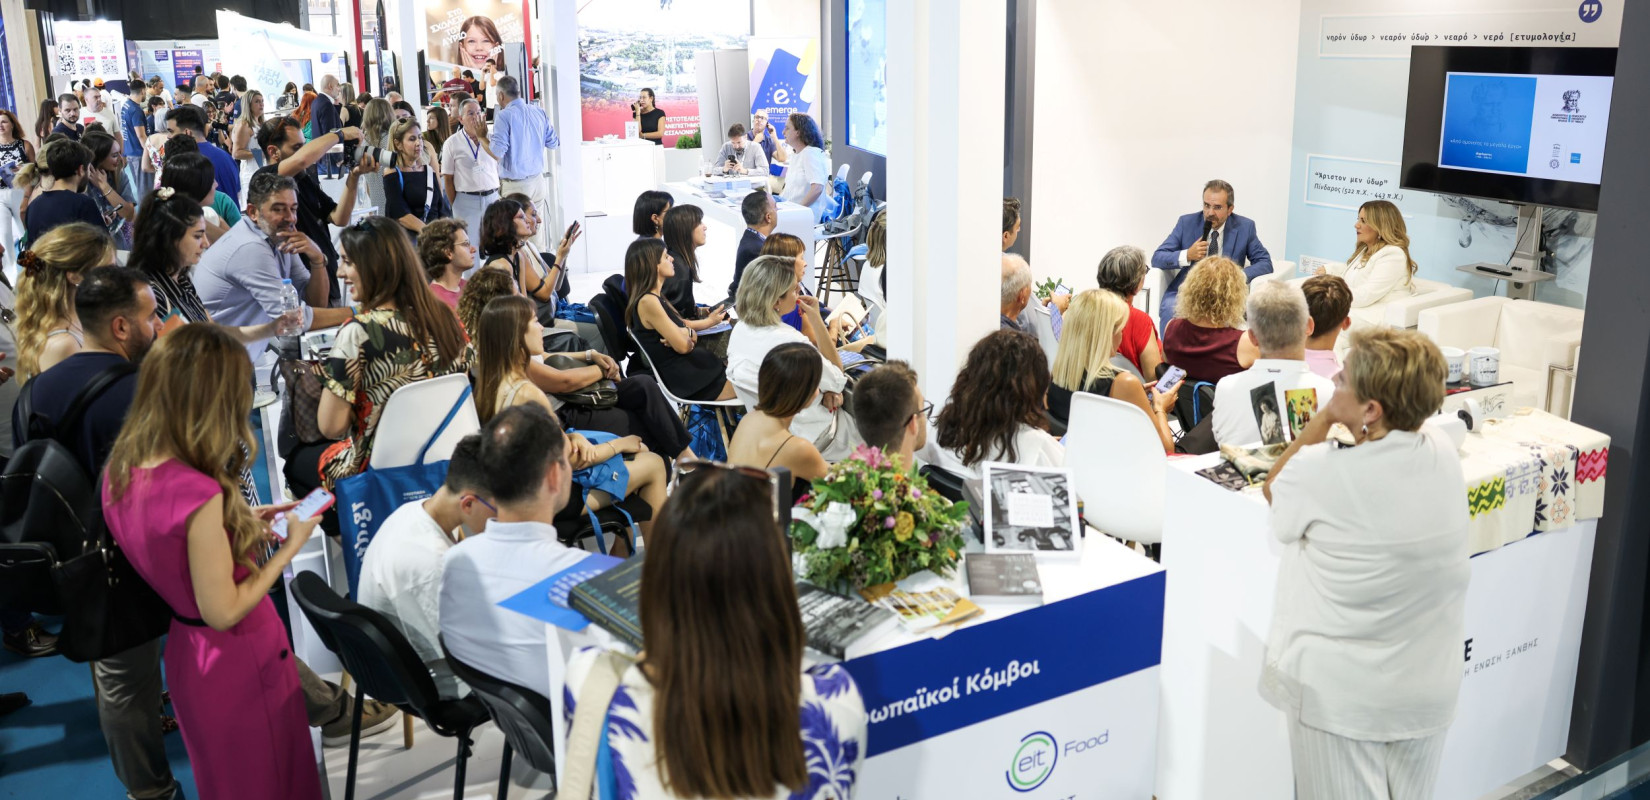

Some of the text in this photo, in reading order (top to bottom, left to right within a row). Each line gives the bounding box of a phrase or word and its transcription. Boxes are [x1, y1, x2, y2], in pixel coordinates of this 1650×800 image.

[1380, 33, 1407, 42] νεαρόν
[1444, 32, 1468, 42] νεαρό
[1483, 32, 1504, 42] νερό
[765, 107, 798, 117] emerge
[1350, 176, 1363, 184] μεν
[1314, 182, 1341, 194] Πίνδαρος
[1341, 187, 1355, 195] (522
[1356, 189, 1369, 197] π.Χ.
[1374, 192, 1386, 200] 443
[1386, 193, 1404, 201] π.Χ.)
[1473, 654, 1502, 673] ΕΝΩΣΗ
[1505, 638, 1539, 659] ΞΑΝΘΗΣ
[966, 660, 1041, 695] Κόμβοι
[1018, 729, 1109, 773] eit Food
